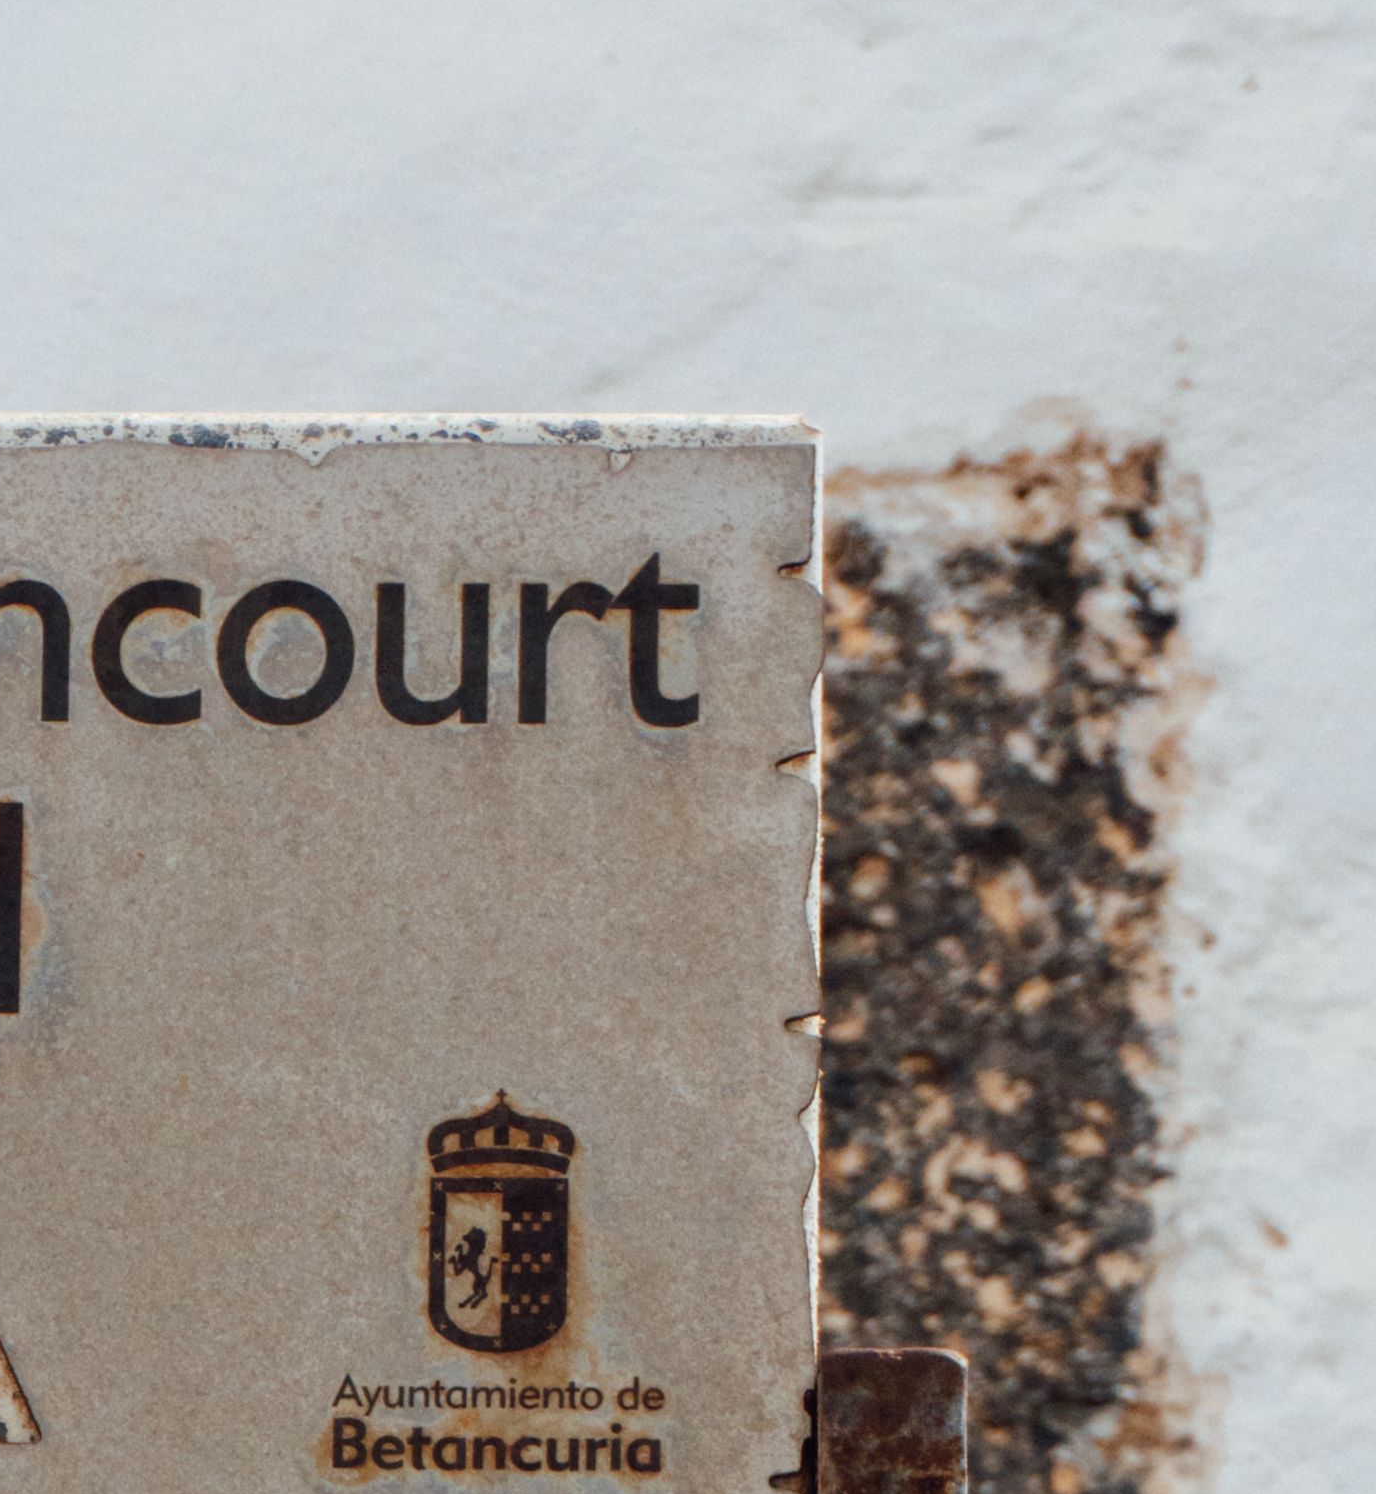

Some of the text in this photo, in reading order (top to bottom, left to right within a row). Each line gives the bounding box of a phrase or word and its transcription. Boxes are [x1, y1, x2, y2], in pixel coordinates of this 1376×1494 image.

[332, 1373, 666, 1415] Ayuntamiento de
[331, 1417, 662, 1472] Betancuria
